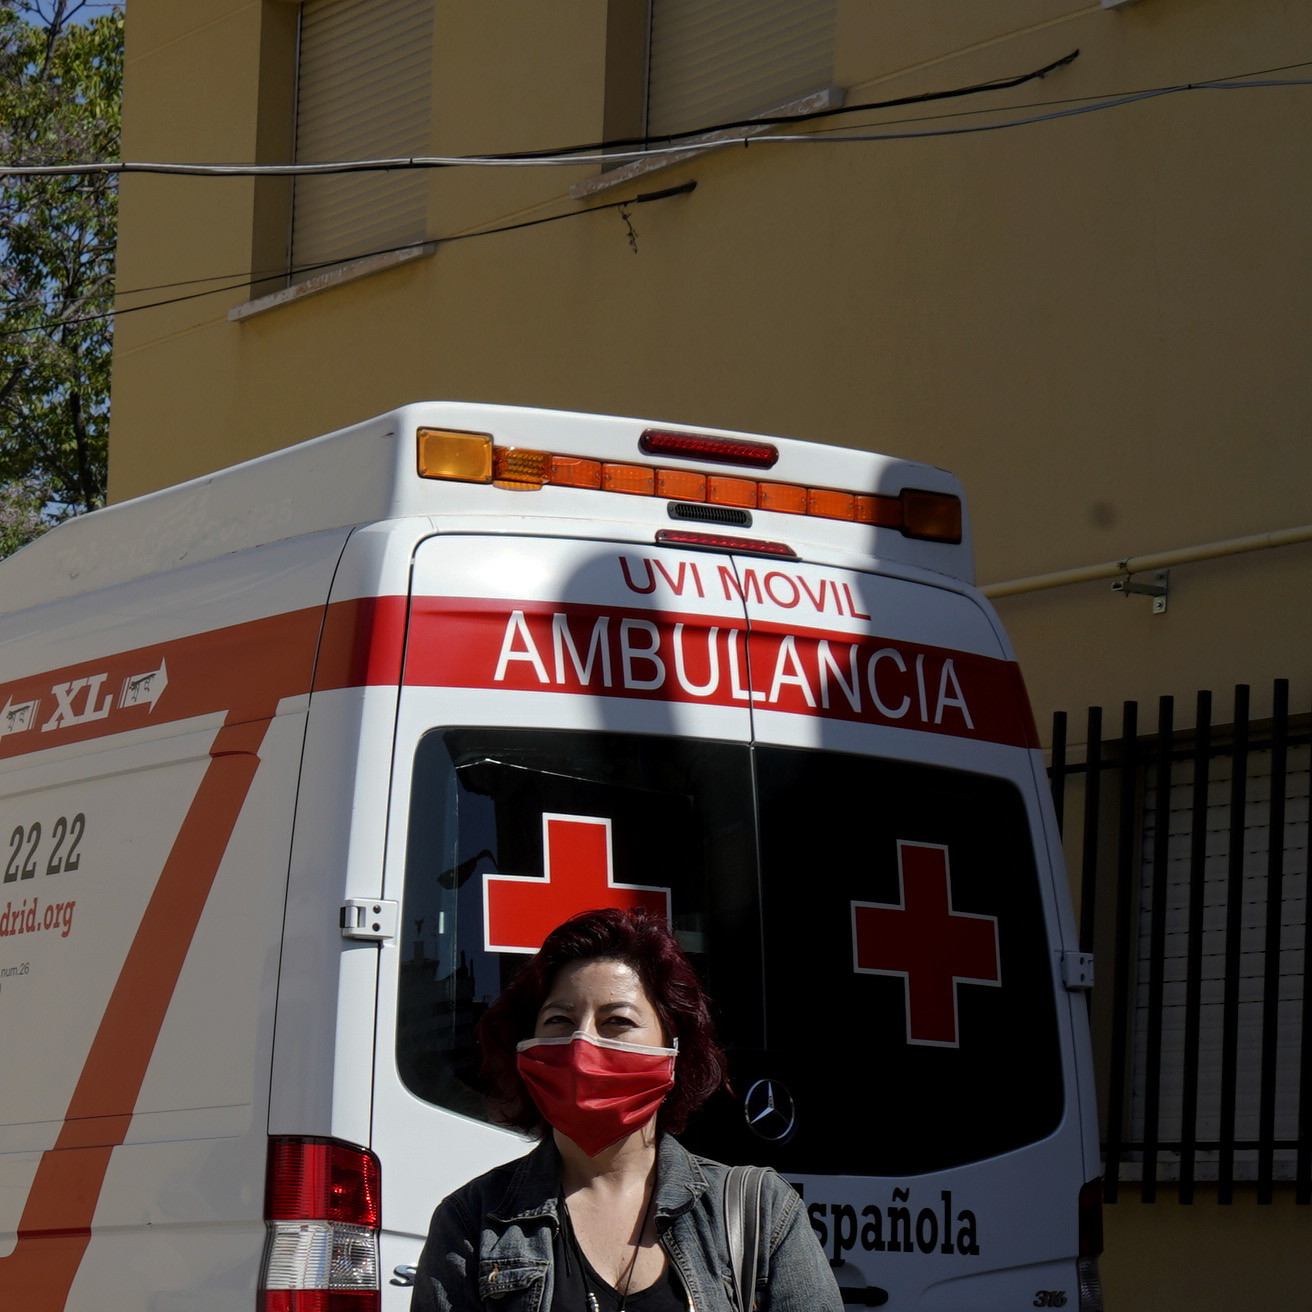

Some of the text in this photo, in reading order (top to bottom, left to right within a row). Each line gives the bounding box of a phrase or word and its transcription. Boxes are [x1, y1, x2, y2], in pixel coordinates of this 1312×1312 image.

[618, 556, 872, 621] UVI MOVIL
[41, 672, 113, 732] XL
[493, 610, 975, 729] AMBULANCIA
[3, 821, 42, 883] 22
[46, 812, 86, 875] 22
[790, 1183, 980, 1267] spañola
[1032, 1289, 1068, 1309] 316
